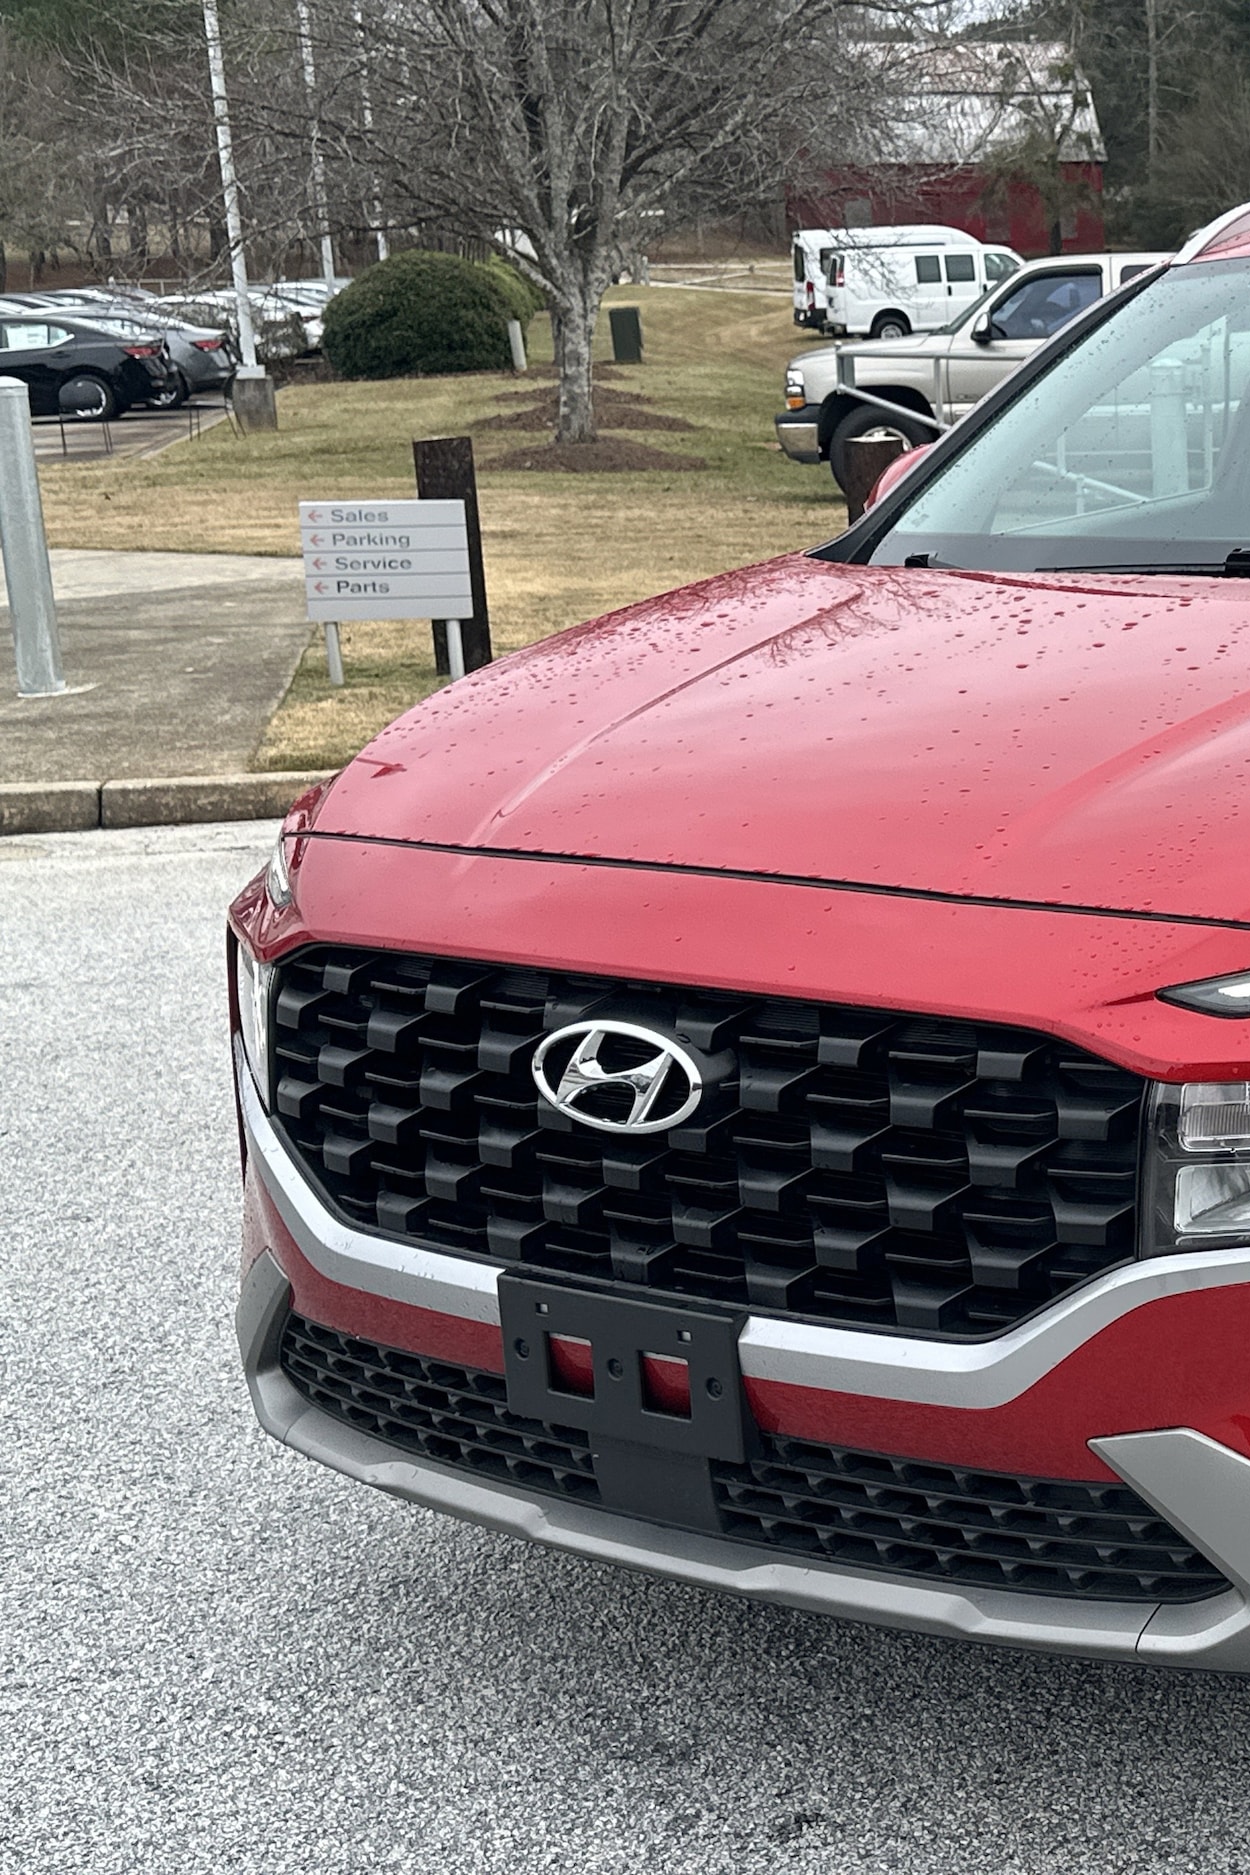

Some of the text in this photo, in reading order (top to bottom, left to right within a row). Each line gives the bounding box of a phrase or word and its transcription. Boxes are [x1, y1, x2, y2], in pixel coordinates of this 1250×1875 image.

[330, 508, 389, 523] Sales
[332, 532, 411, 549] Parking
[335, 555, 412, 571] Service
[336, 579, 390, 594] Parts
